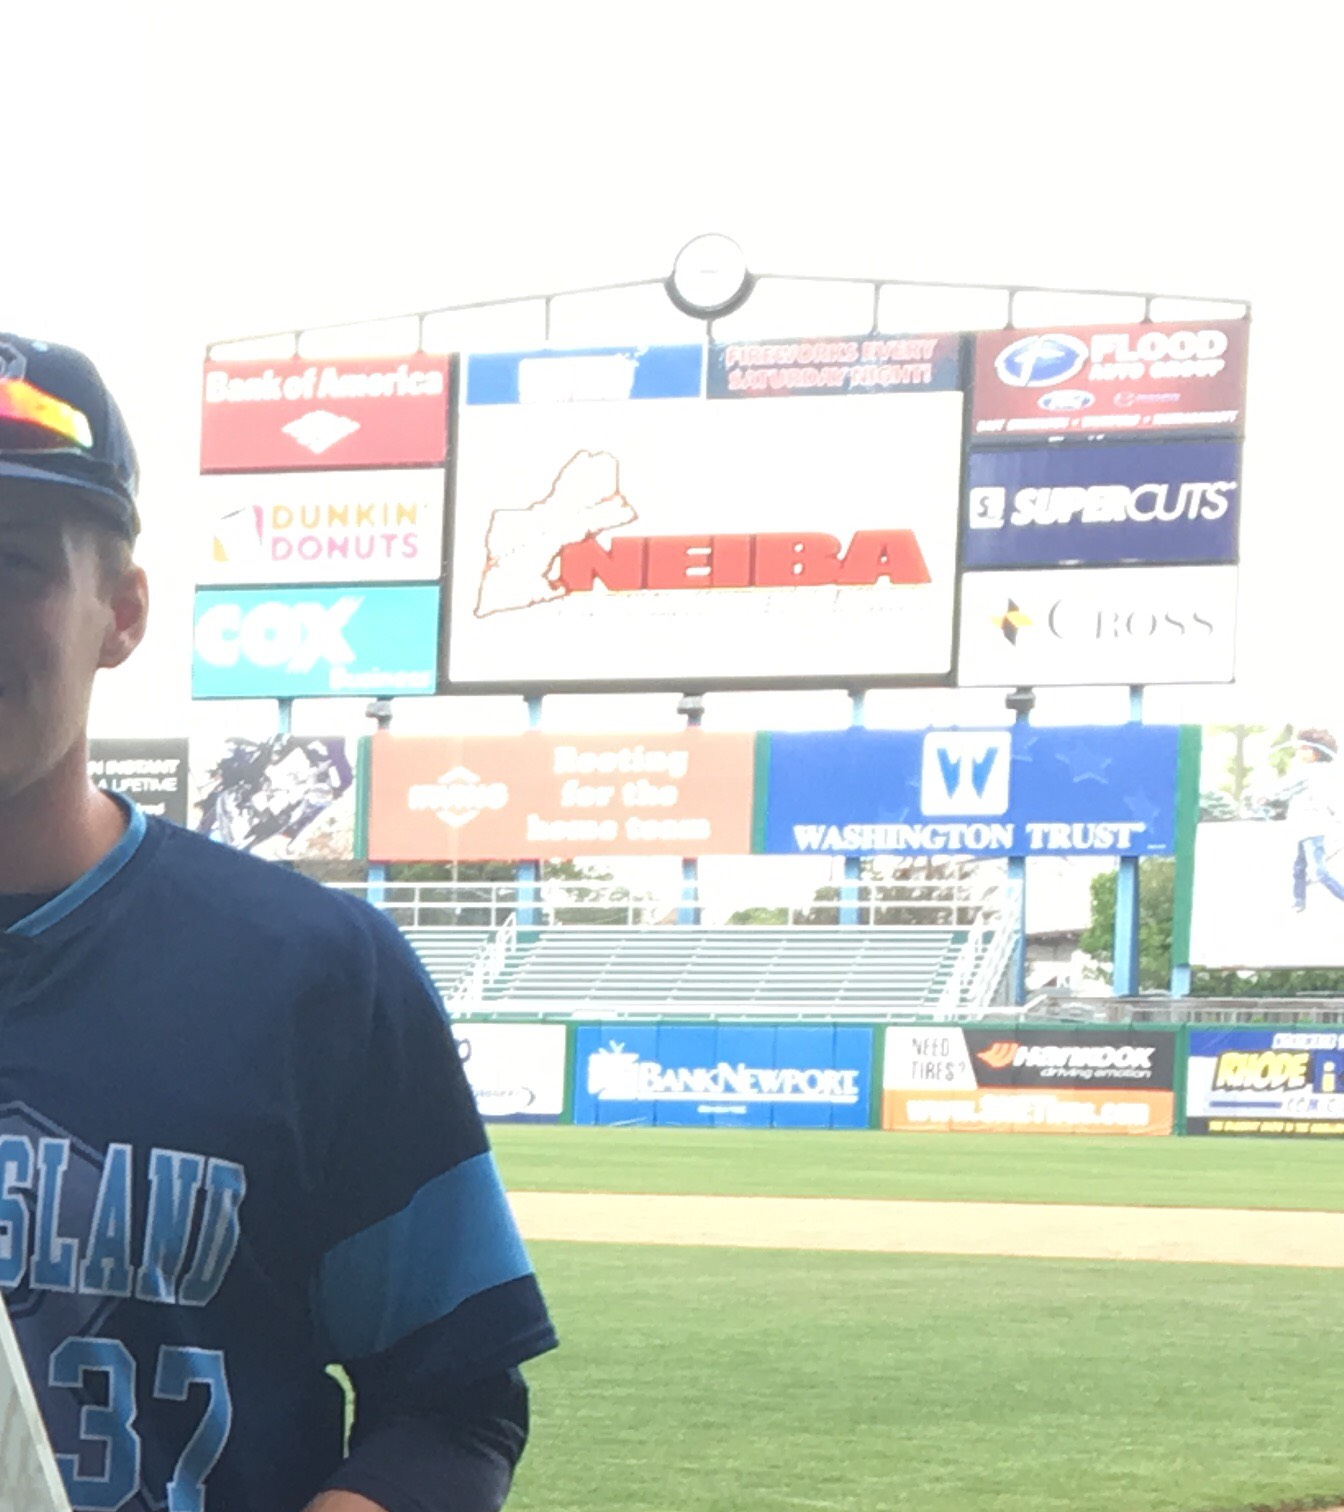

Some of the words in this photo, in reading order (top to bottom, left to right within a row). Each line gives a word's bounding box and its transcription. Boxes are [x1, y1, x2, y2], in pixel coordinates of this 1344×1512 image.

[1091, 329, 1228, 363] FLOOD
[205, 368, 283, 402] Bank
[284, 368, 316, 399] of
[316, 366, 443, 399] America
[270, 501, 418, 530] DUNKIN
[1011, 481, 1231, 527] SUPERCUTS
[270, 533, 418, 561] DONUTS
[560, 528, 932, 592] NEIBA
[793, 822, 1016, 852] WASHINGTON
[1025, 822, 1136, 850] TRUST
[912, 1037, 950, 1058] NEED
[911, 1061, 966, 1082] TIRES?
[1211, 1050, 1310, 1092] RHODE
